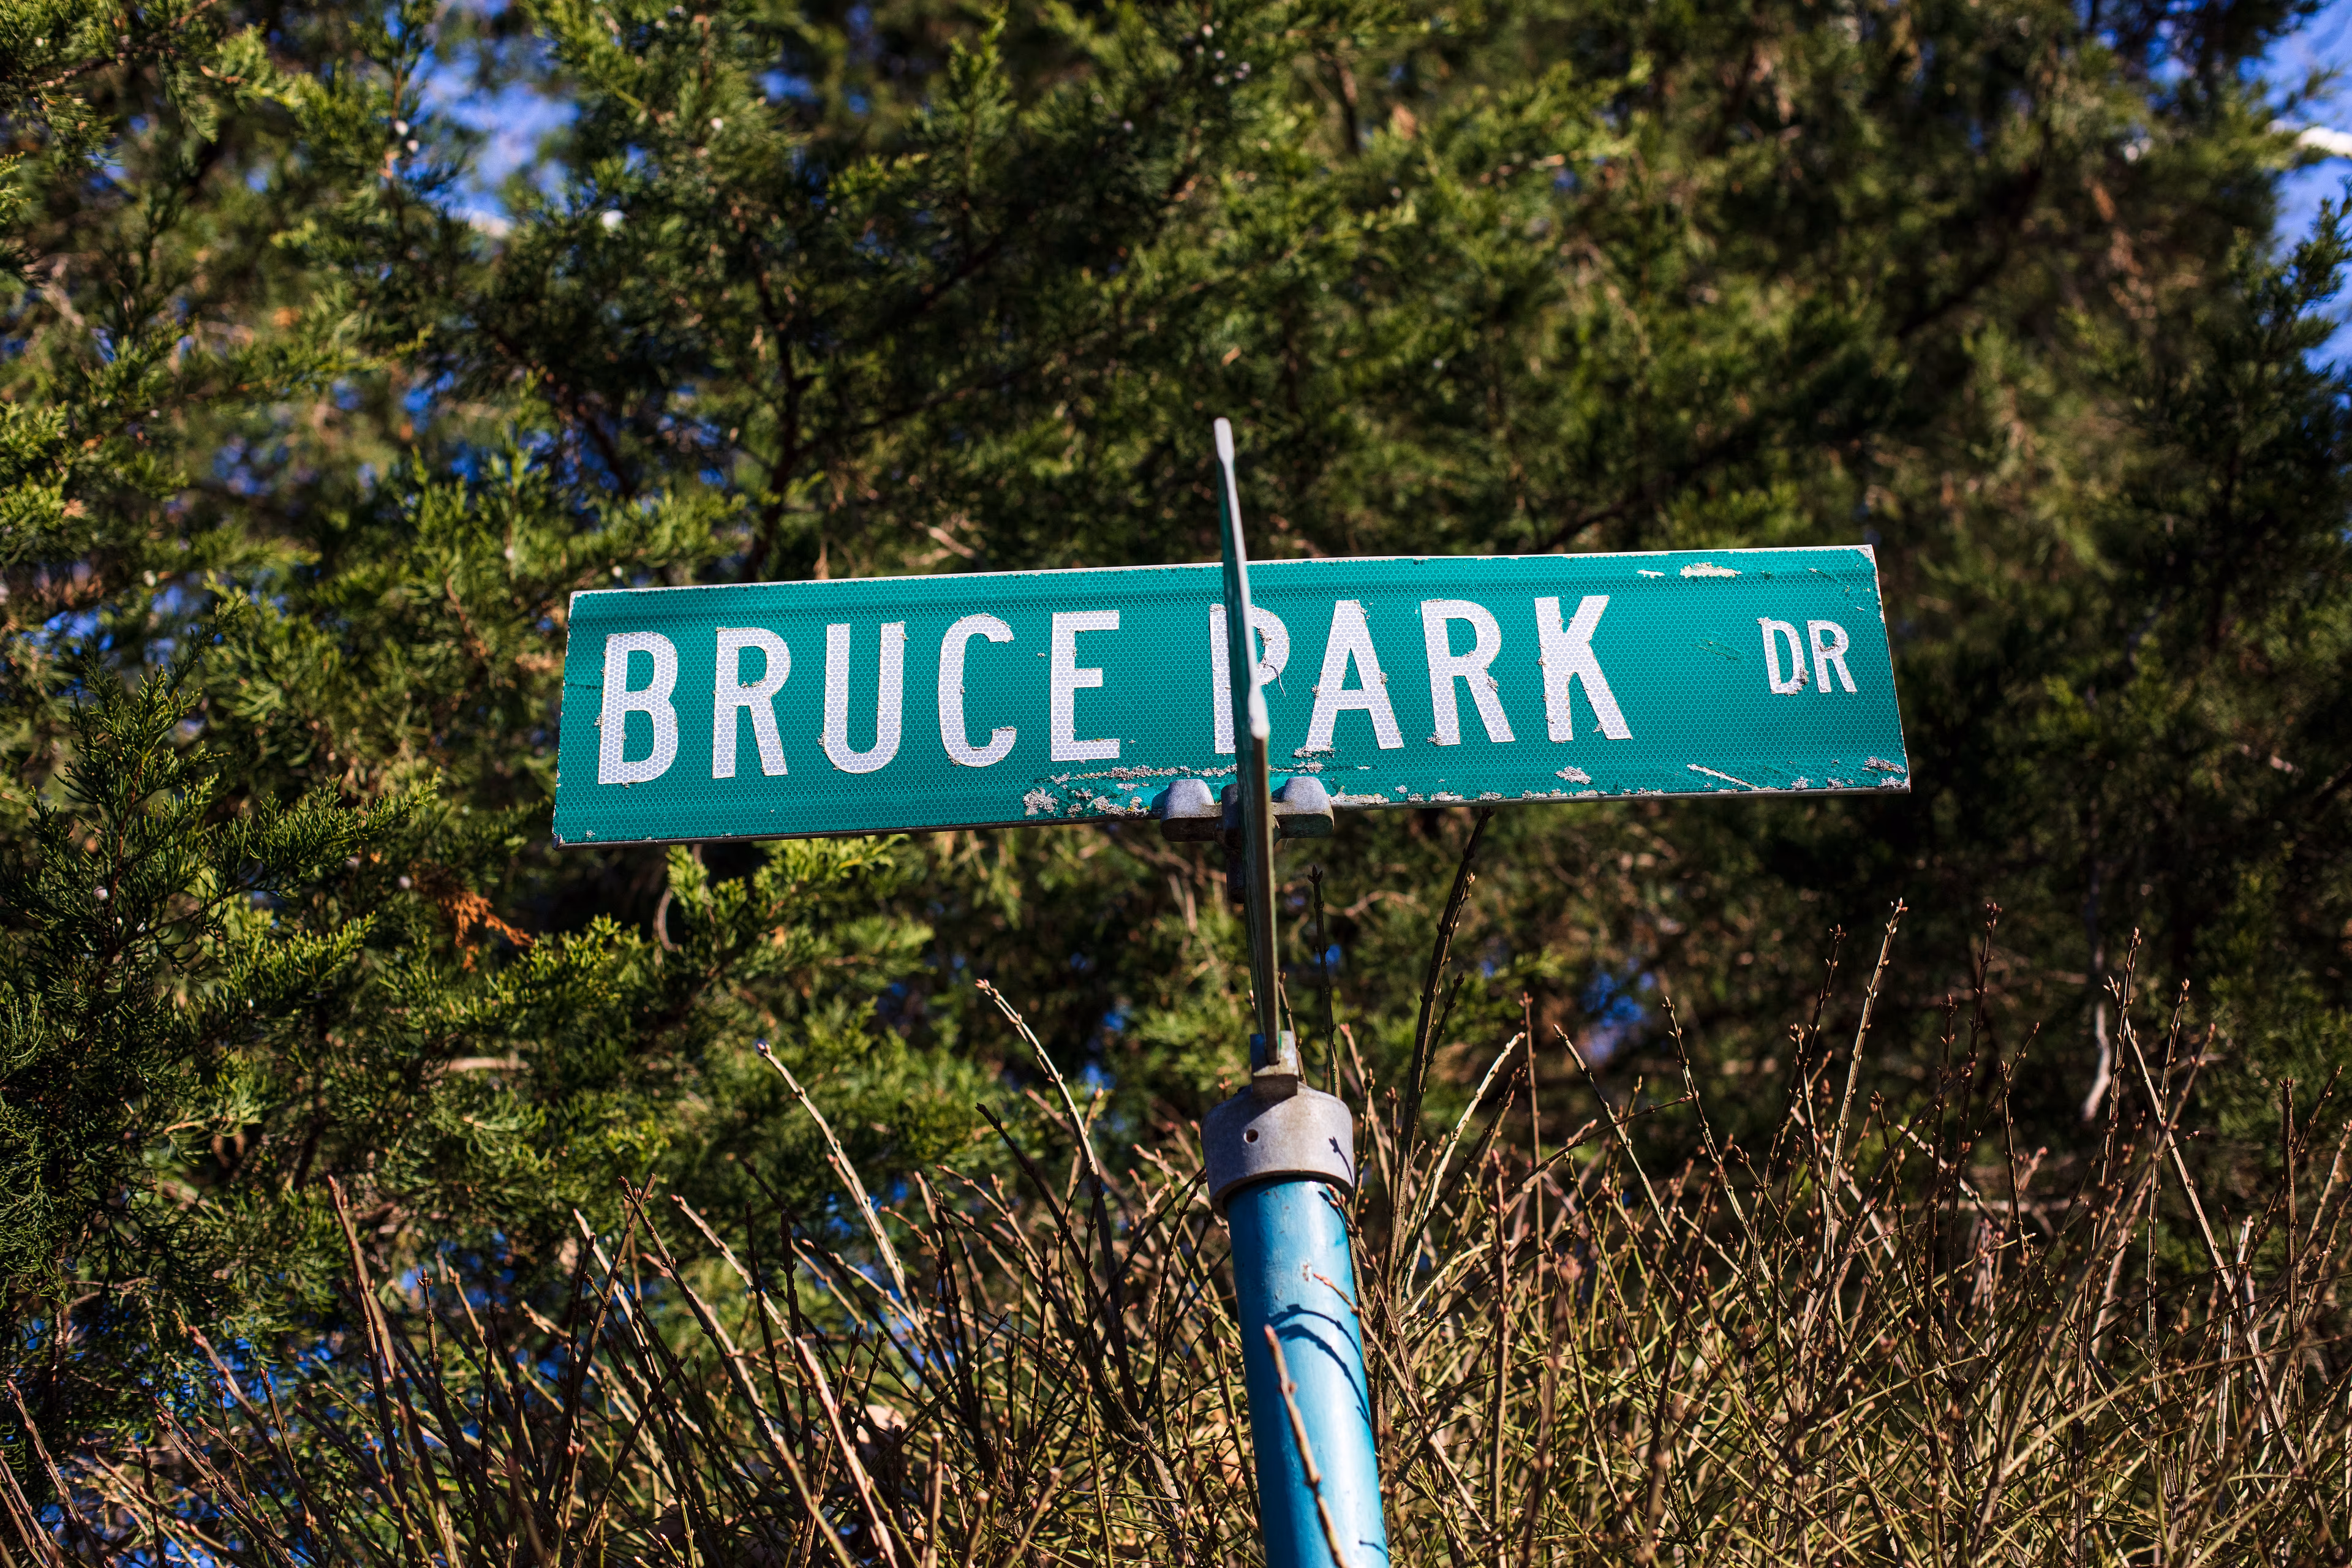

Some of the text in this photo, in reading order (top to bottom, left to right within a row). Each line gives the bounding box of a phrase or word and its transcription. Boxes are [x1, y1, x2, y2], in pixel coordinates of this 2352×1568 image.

[597, 594, 1858, 785] BRUCE PARK DR
